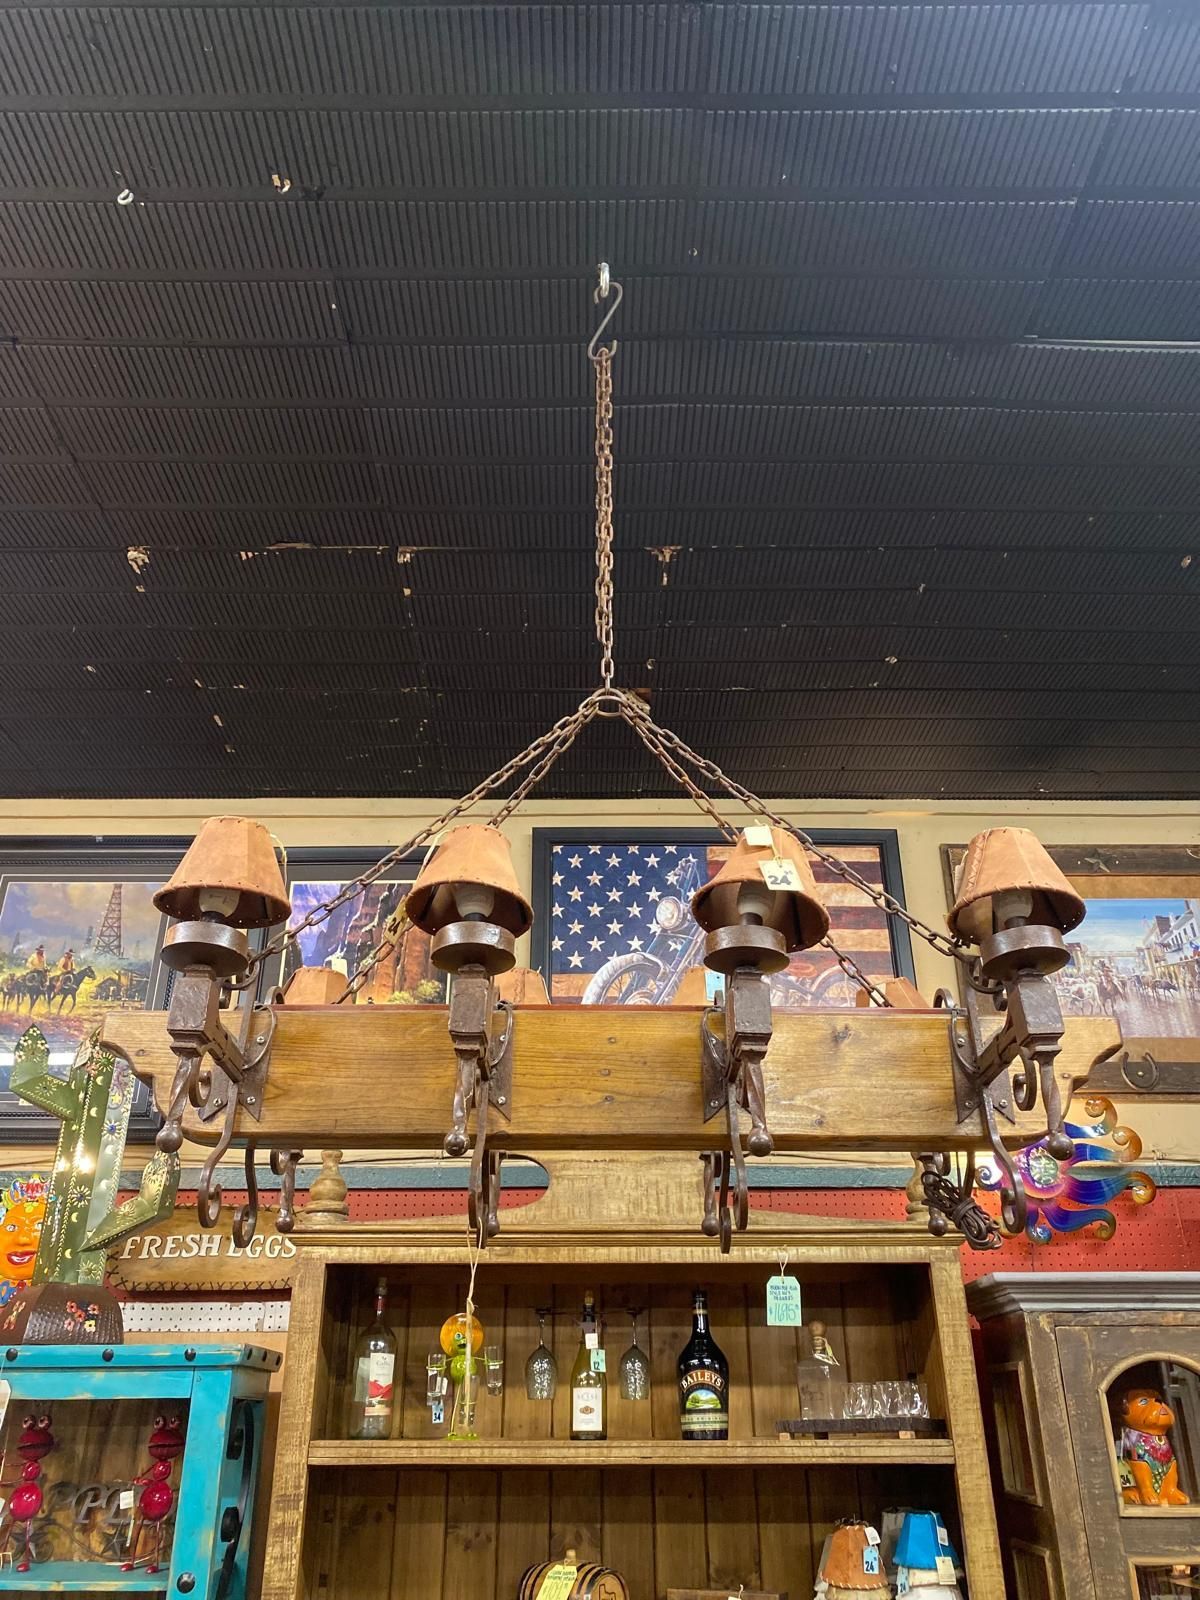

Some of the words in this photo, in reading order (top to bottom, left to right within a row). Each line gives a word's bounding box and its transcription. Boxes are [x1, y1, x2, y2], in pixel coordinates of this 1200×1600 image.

[119, 1233, 223, 1259] FRESH
[681, 1371, 722, 1389] BAILEYS
[865, 1560, 875, 1573] 24
